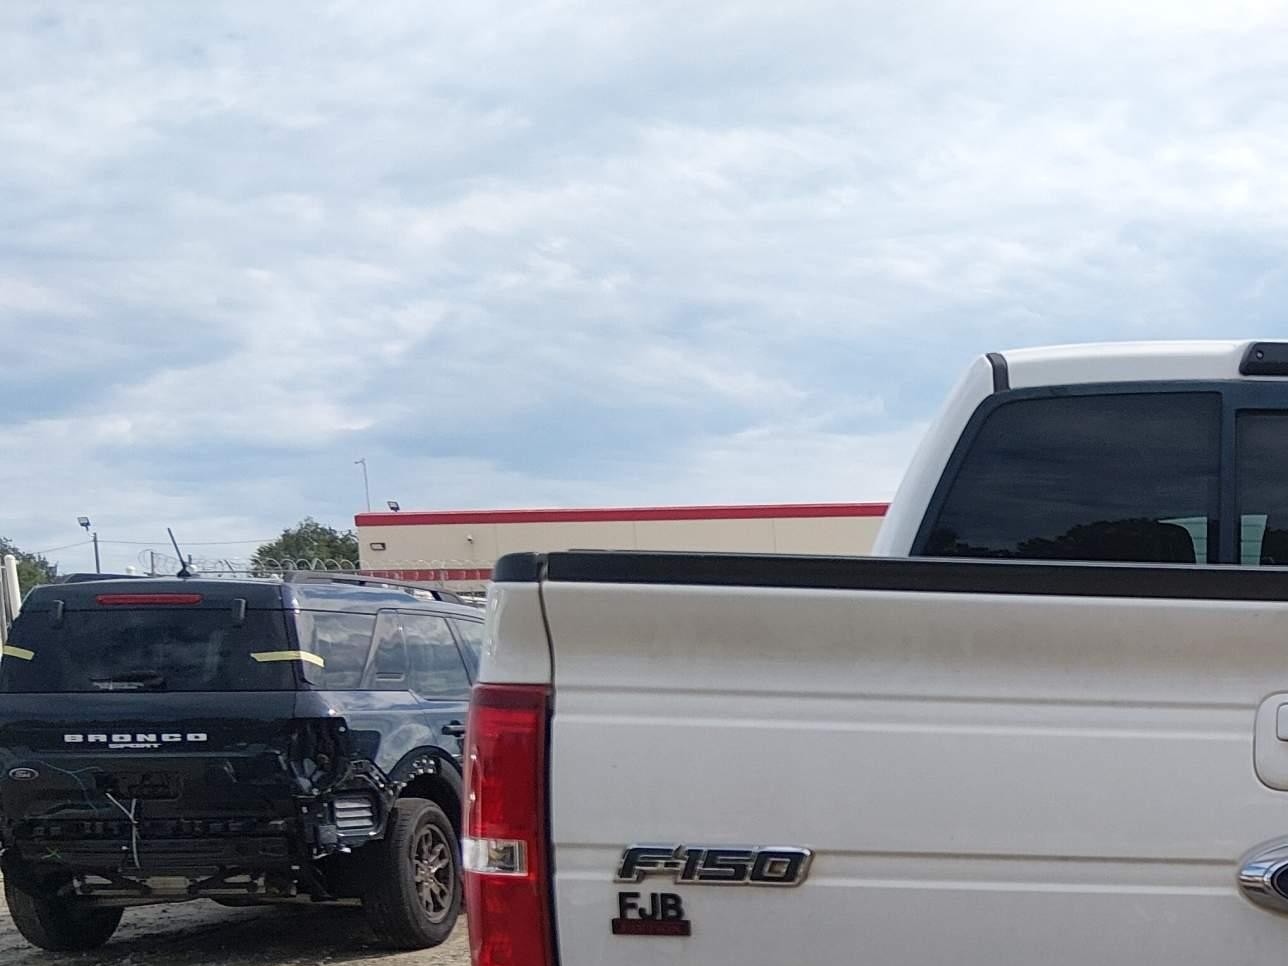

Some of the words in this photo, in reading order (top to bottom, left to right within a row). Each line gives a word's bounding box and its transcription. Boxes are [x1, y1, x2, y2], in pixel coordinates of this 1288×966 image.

[63, 733, 208, 743] BRONCO
[614, 843, 815, 886] F-150
[619, 892, 684, 920] FJB
